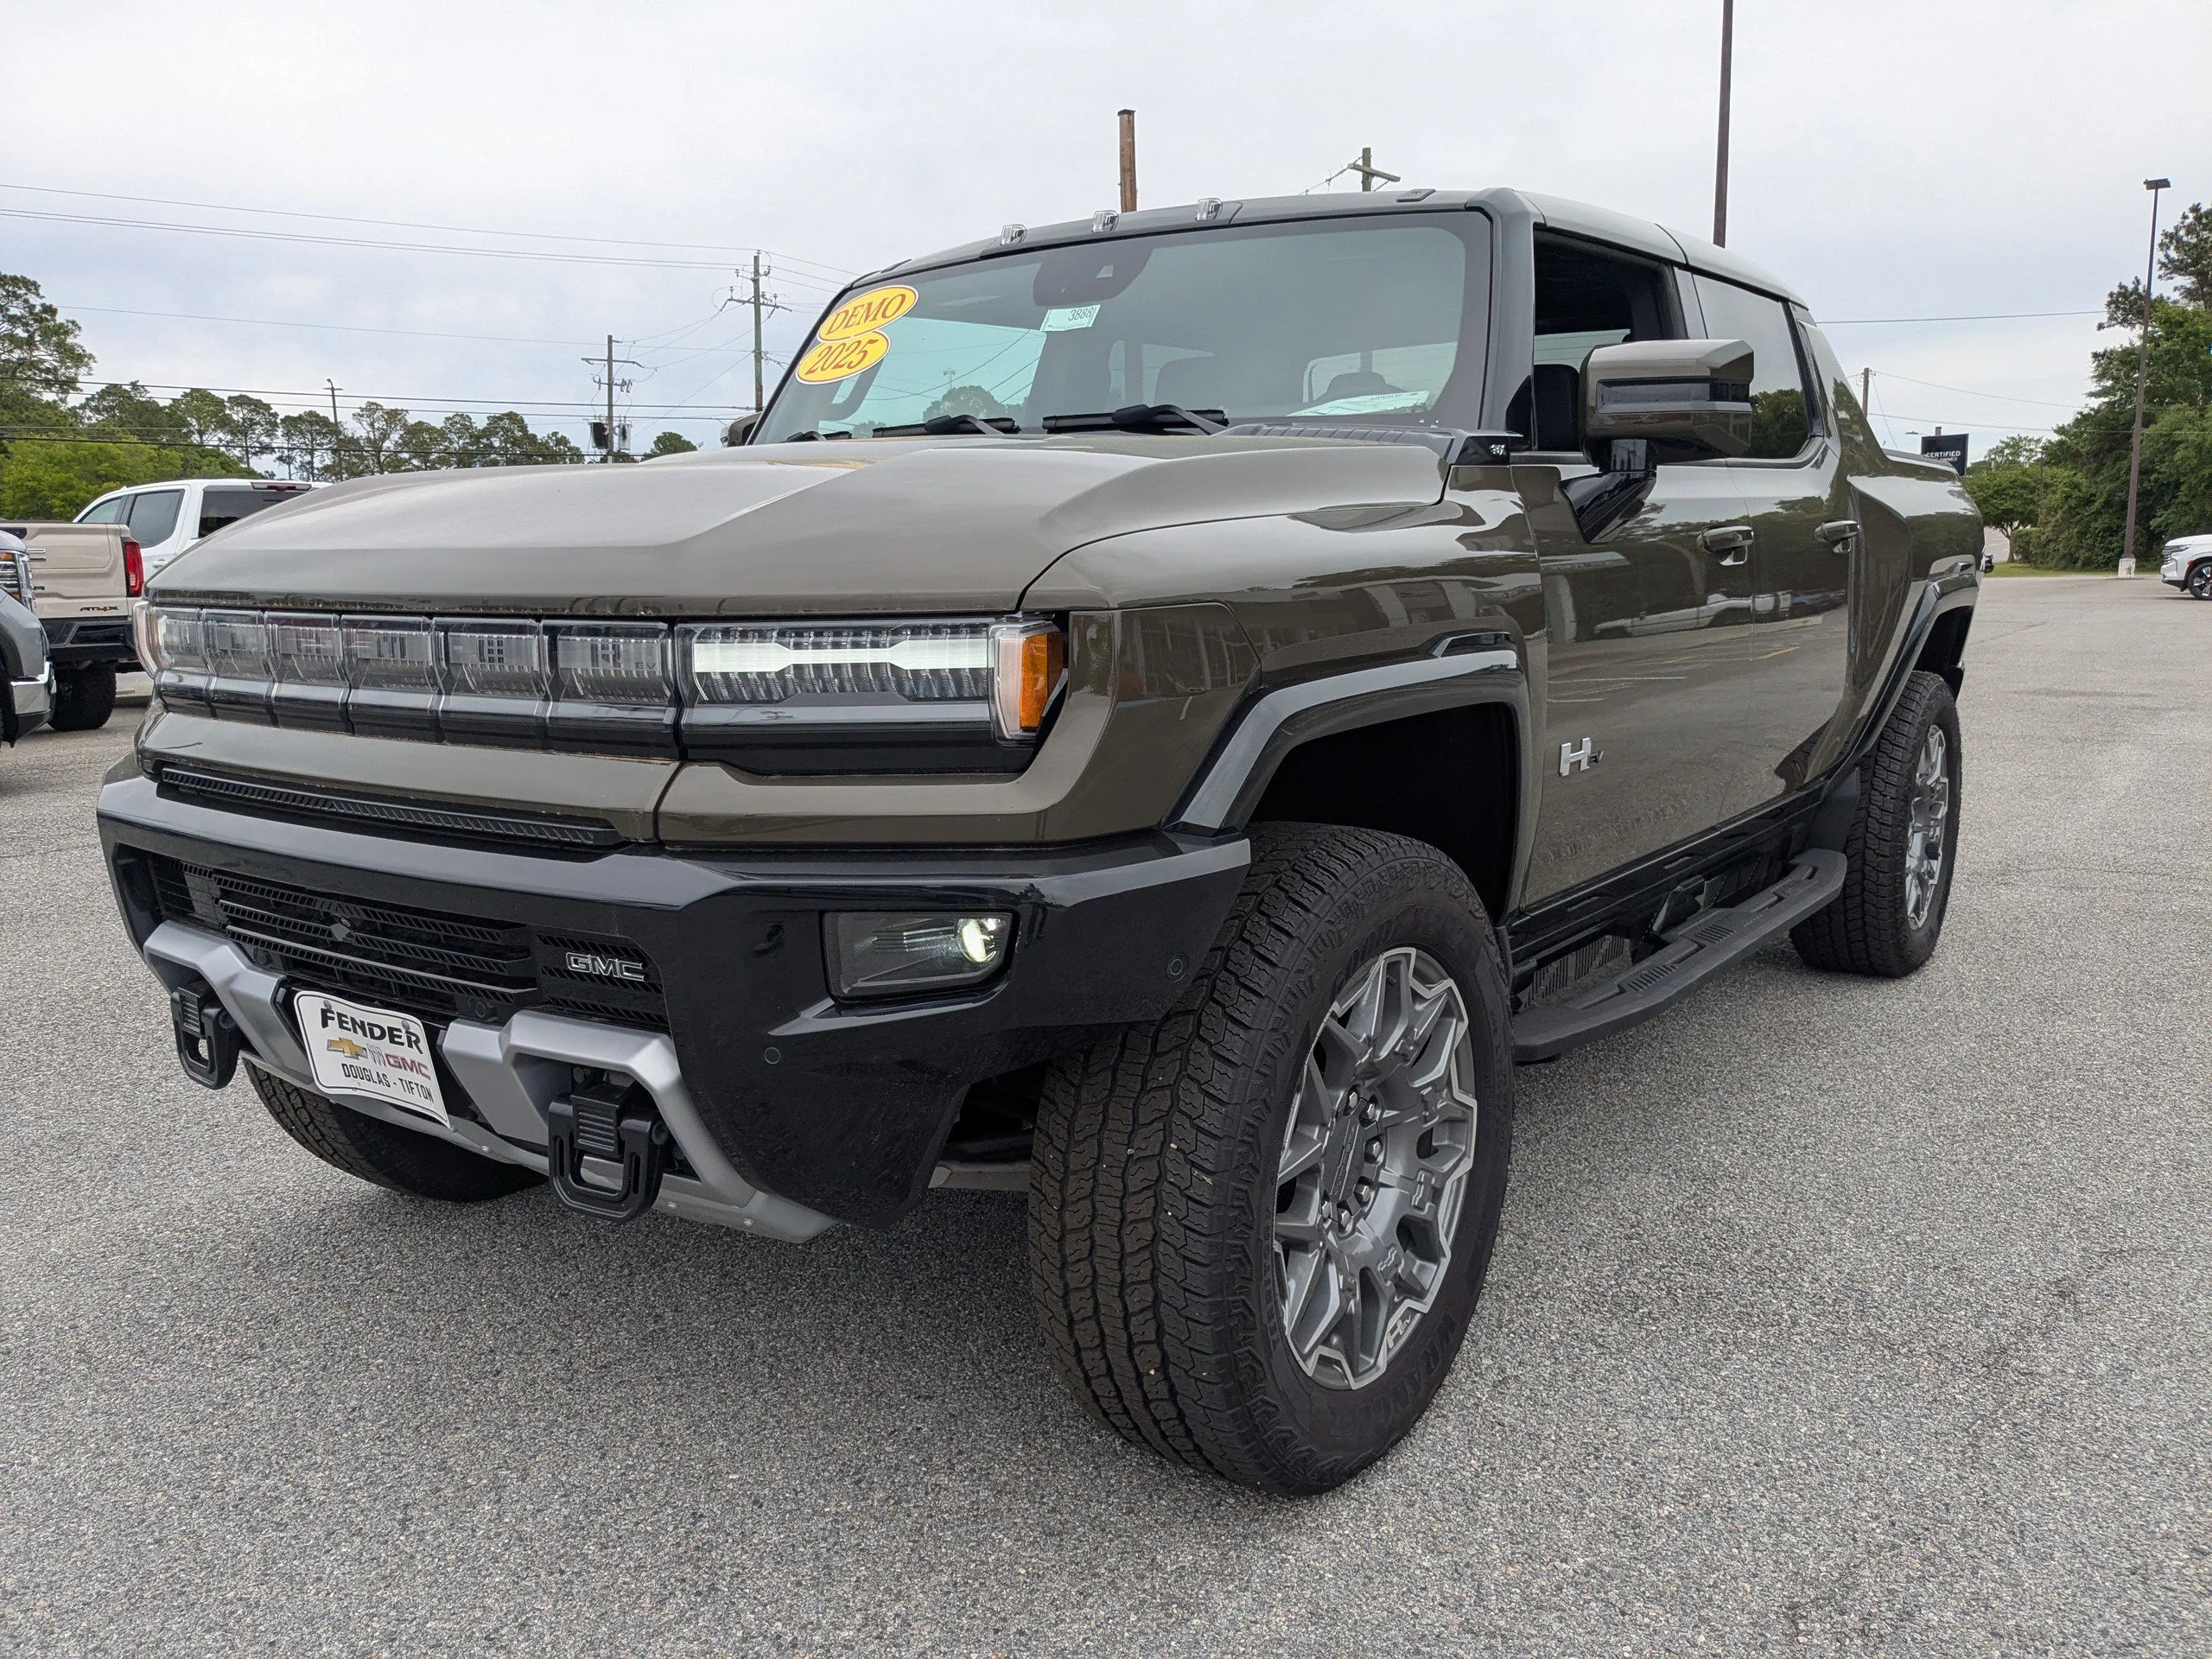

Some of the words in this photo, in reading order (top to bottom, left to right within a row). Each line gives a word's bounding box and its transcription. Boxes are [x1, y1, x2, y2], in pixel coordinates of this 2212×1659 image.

[826, 294, 906, 335] DEMO
[804, 339, 879, 375] 2025
[565, 952, 645, 982] GMC
[321, 1007, 424, 1054] FENDER
[341, 1063, 391, 1089] DOUGLAS
[398, 1077, 435, 1103] TIFTON
[385, 1052, 432, 1081] GMC
